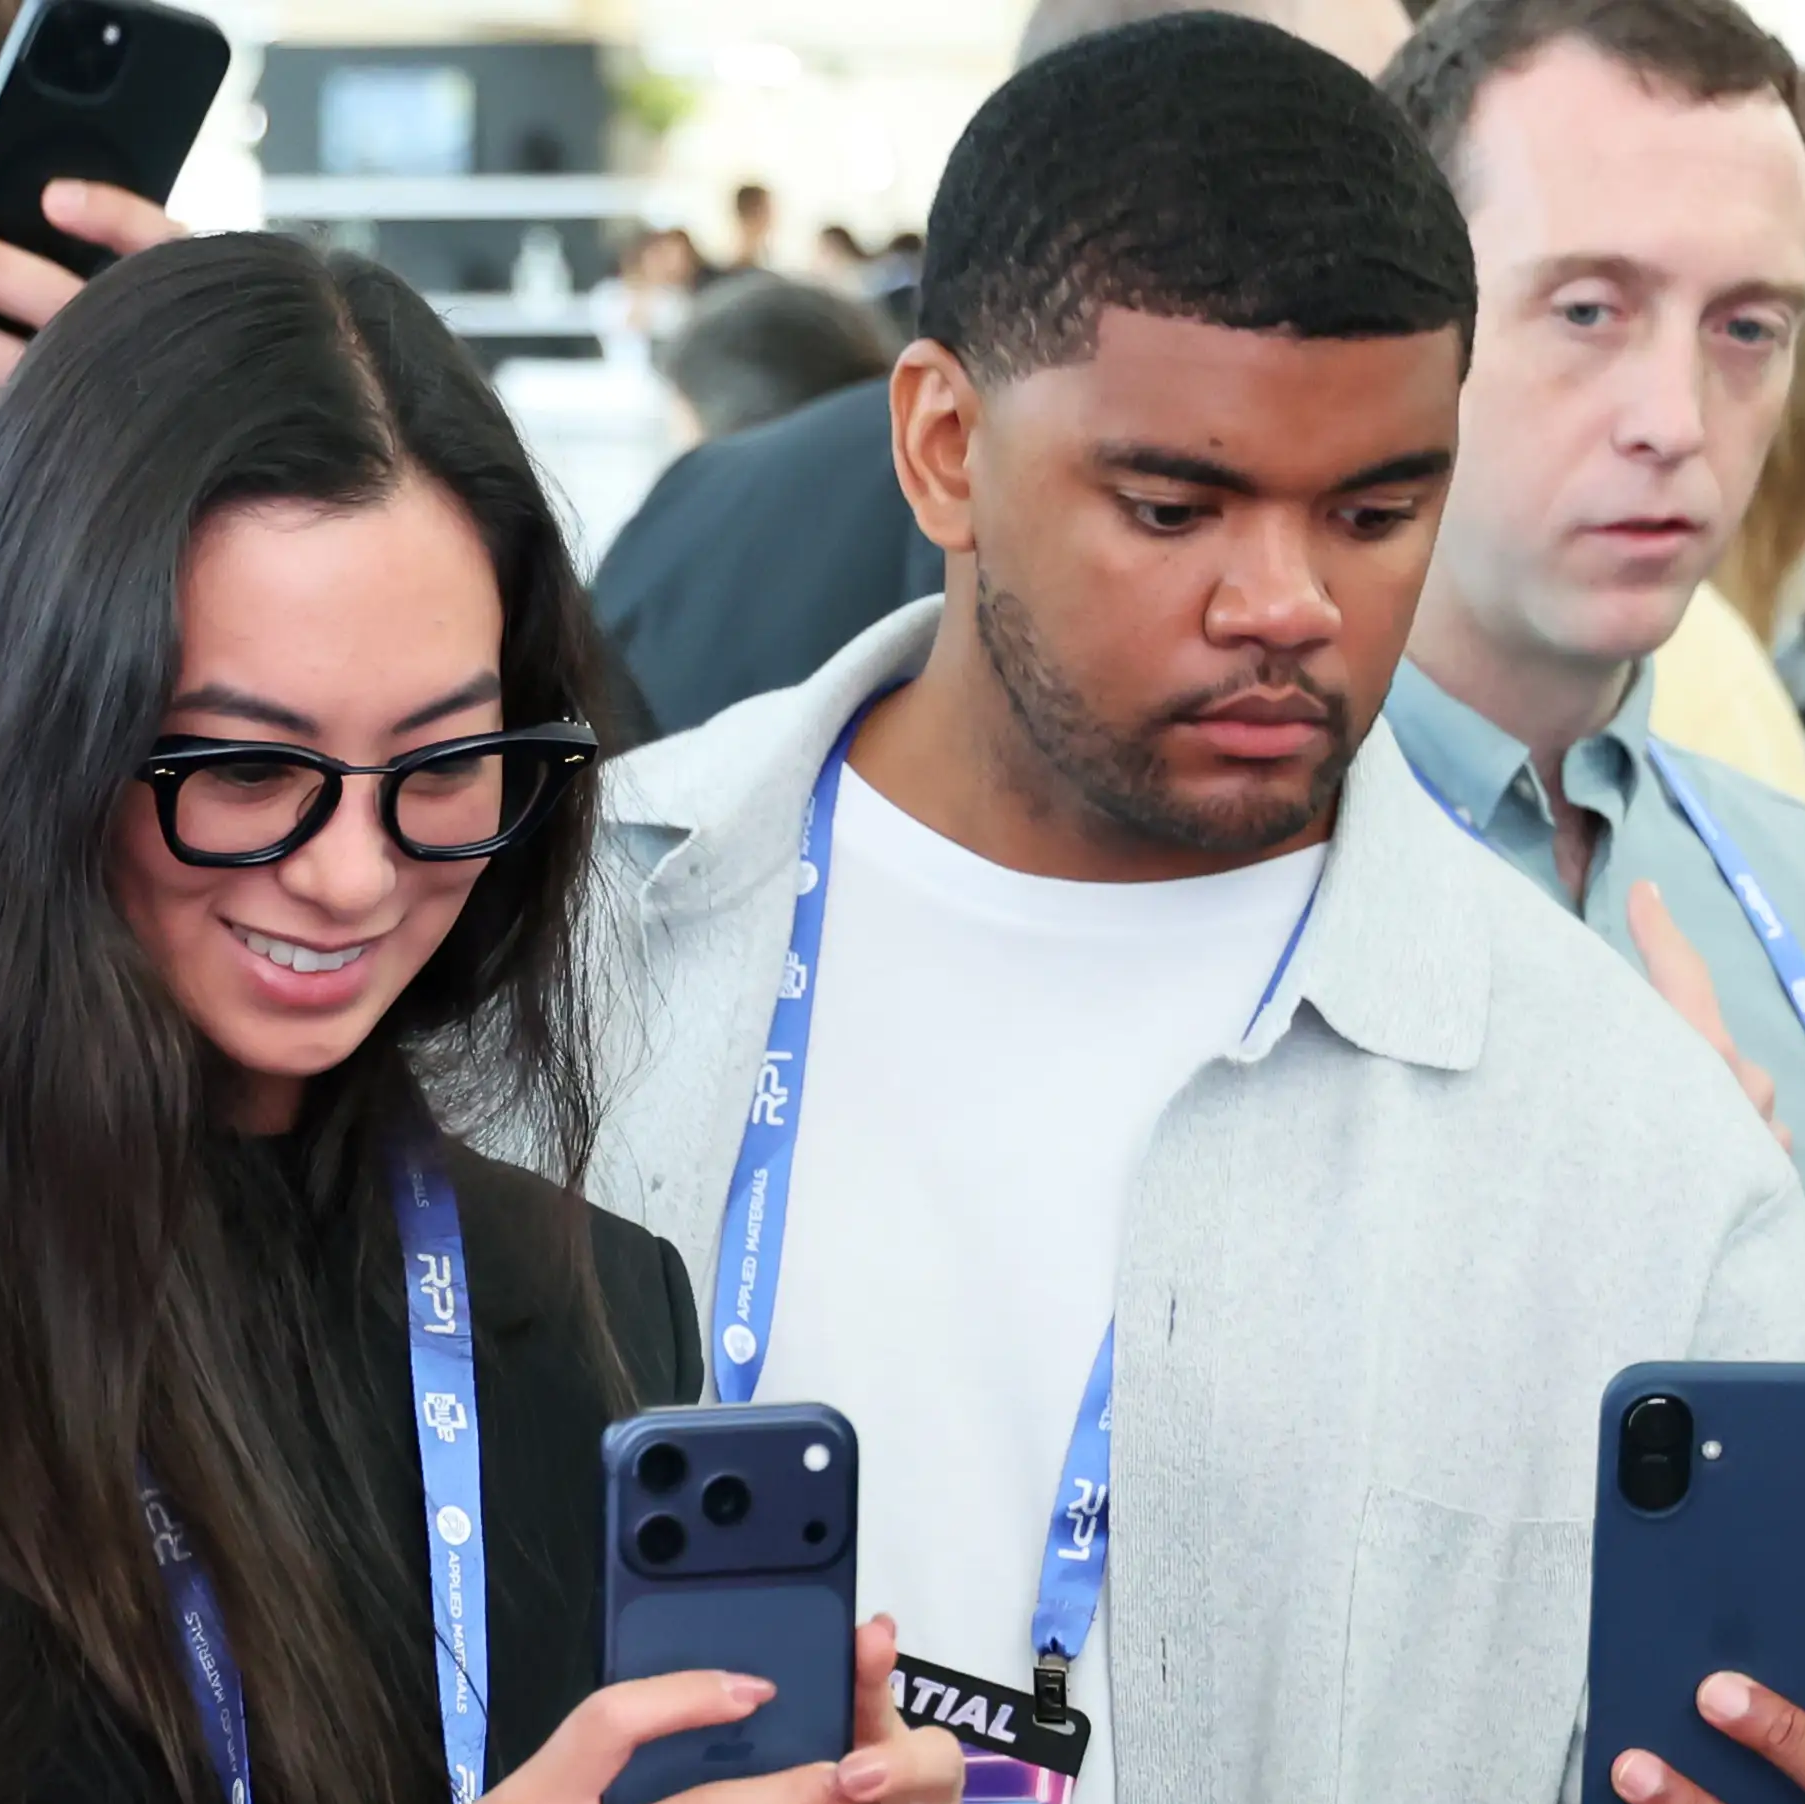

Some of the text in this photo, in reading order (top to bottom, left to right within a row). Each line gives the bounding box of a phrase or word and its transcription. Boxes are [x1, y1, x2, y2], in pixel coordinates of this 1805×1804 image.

[752, 1049, 793, 1126] RP1
[736, 1167, 768, 1322] APPLIED MATERIALS
[417, 1253, 456, 1335] RP1
[1057, 1477, 1108, 1562] RP1
[447, 1550, 463, 1619] APPLIED
[184, 1611, 225, 1704] MATERIALS
[889, 1669, 1016, 1744] ATIAL
